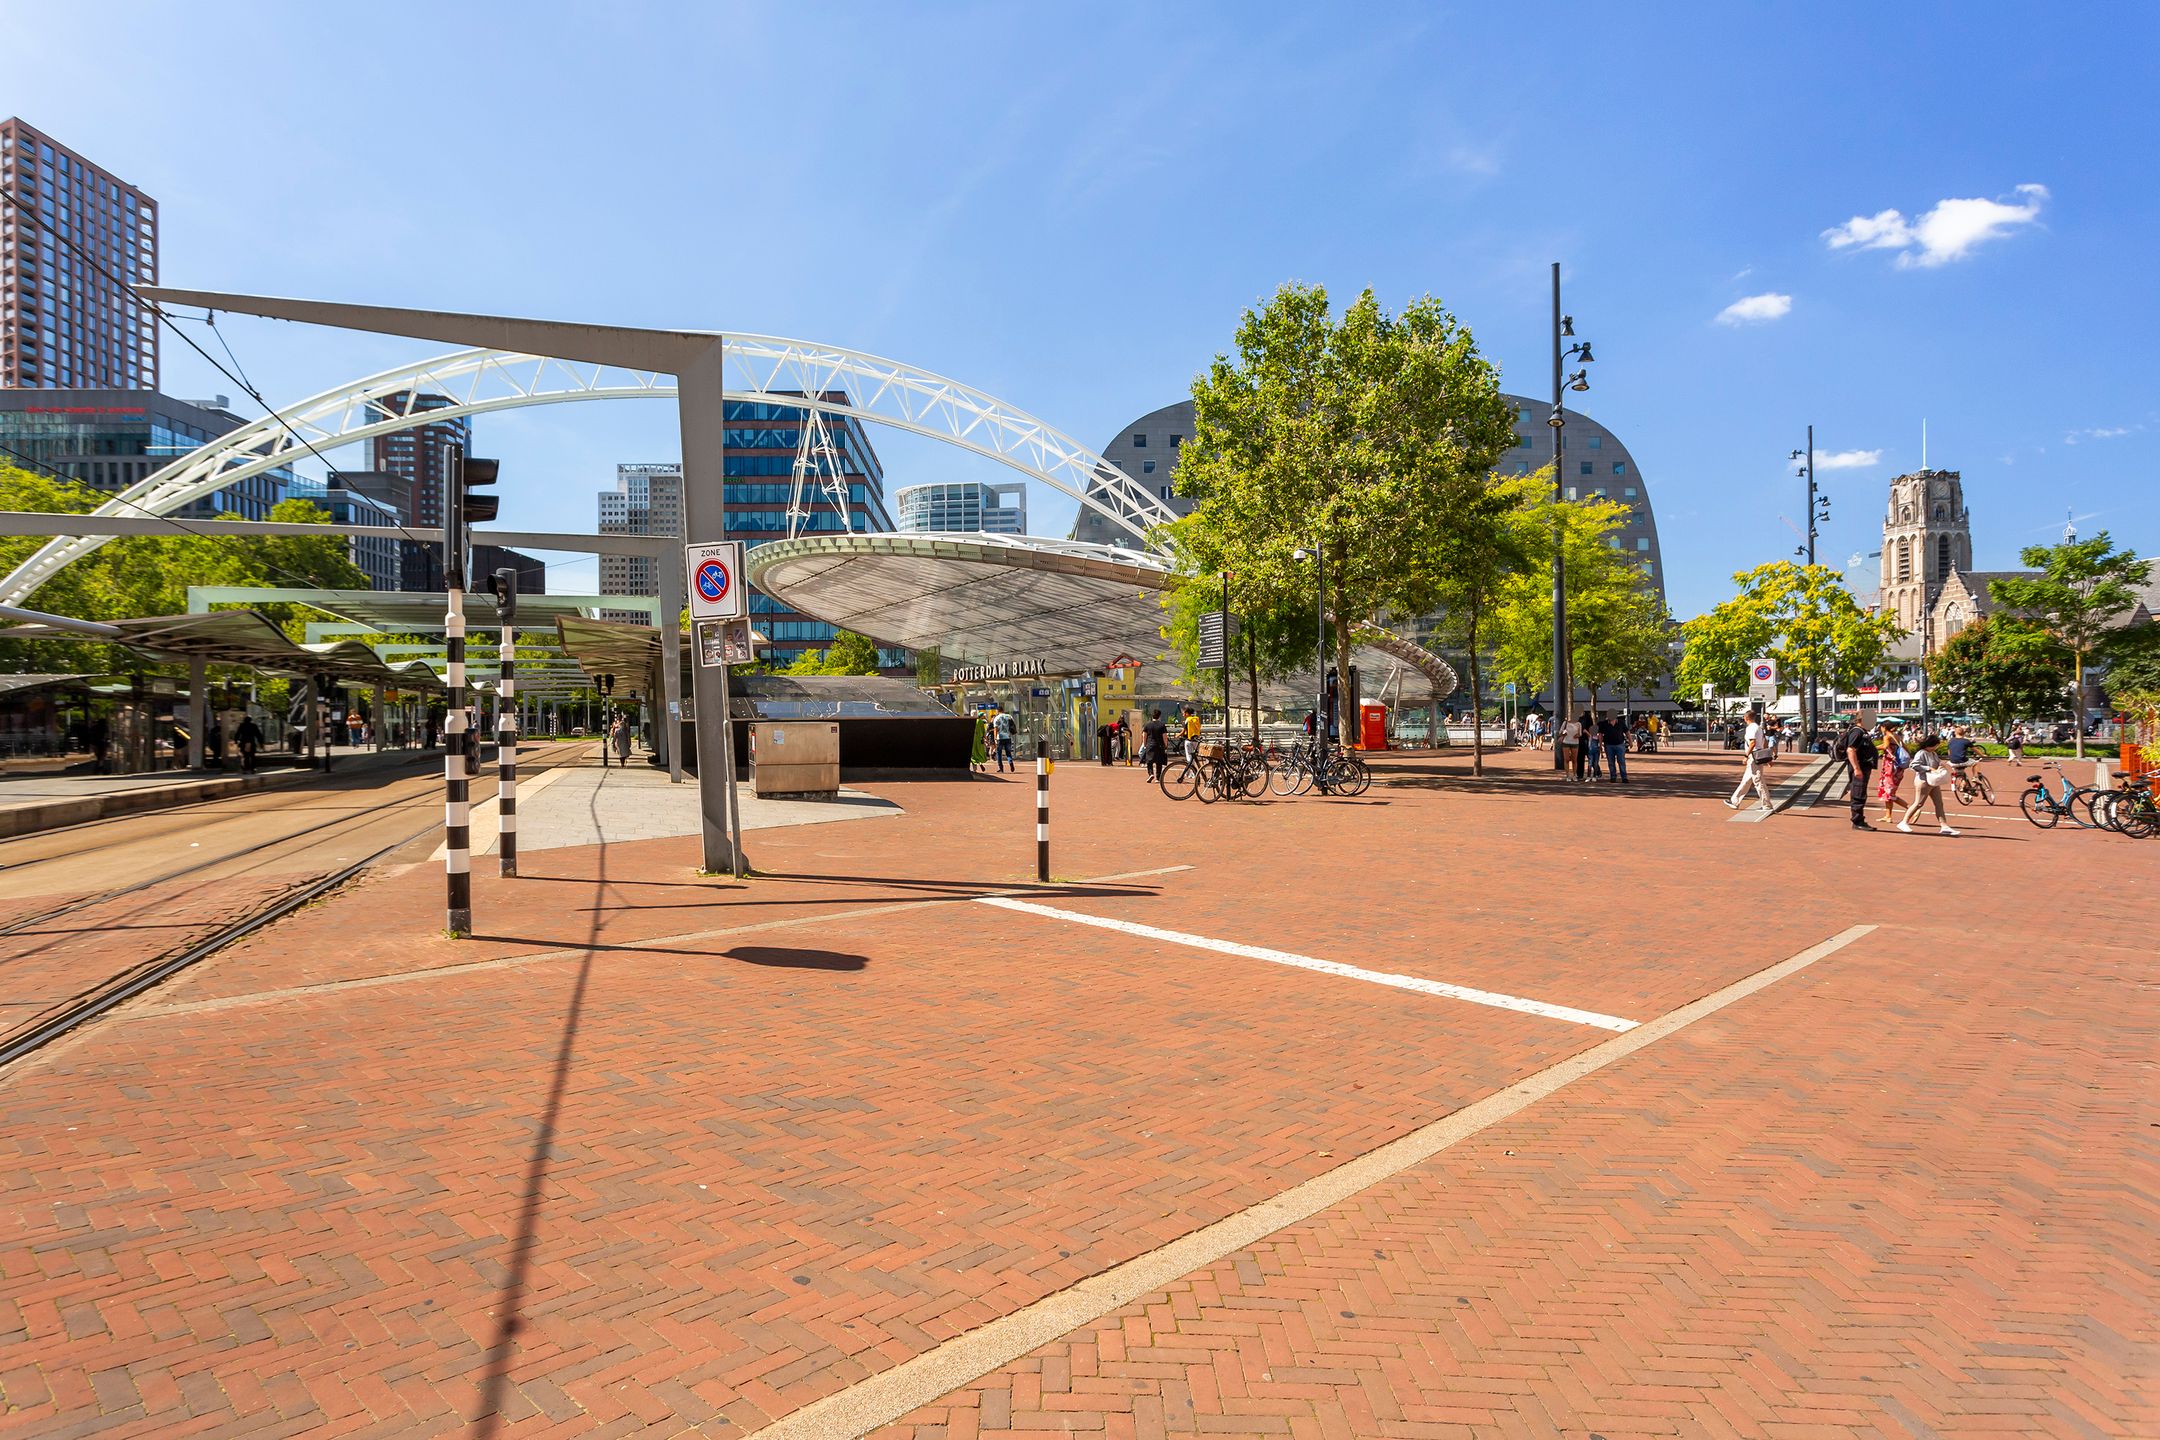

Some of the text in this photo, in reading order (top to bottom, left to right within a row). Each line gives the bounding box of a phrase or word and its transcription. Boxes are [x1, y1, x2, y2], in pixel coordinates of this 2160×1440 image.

[701, 549, 720, 557] ZONE
[953, 659, 1046, 682] ROTTERDAM BLAAK
